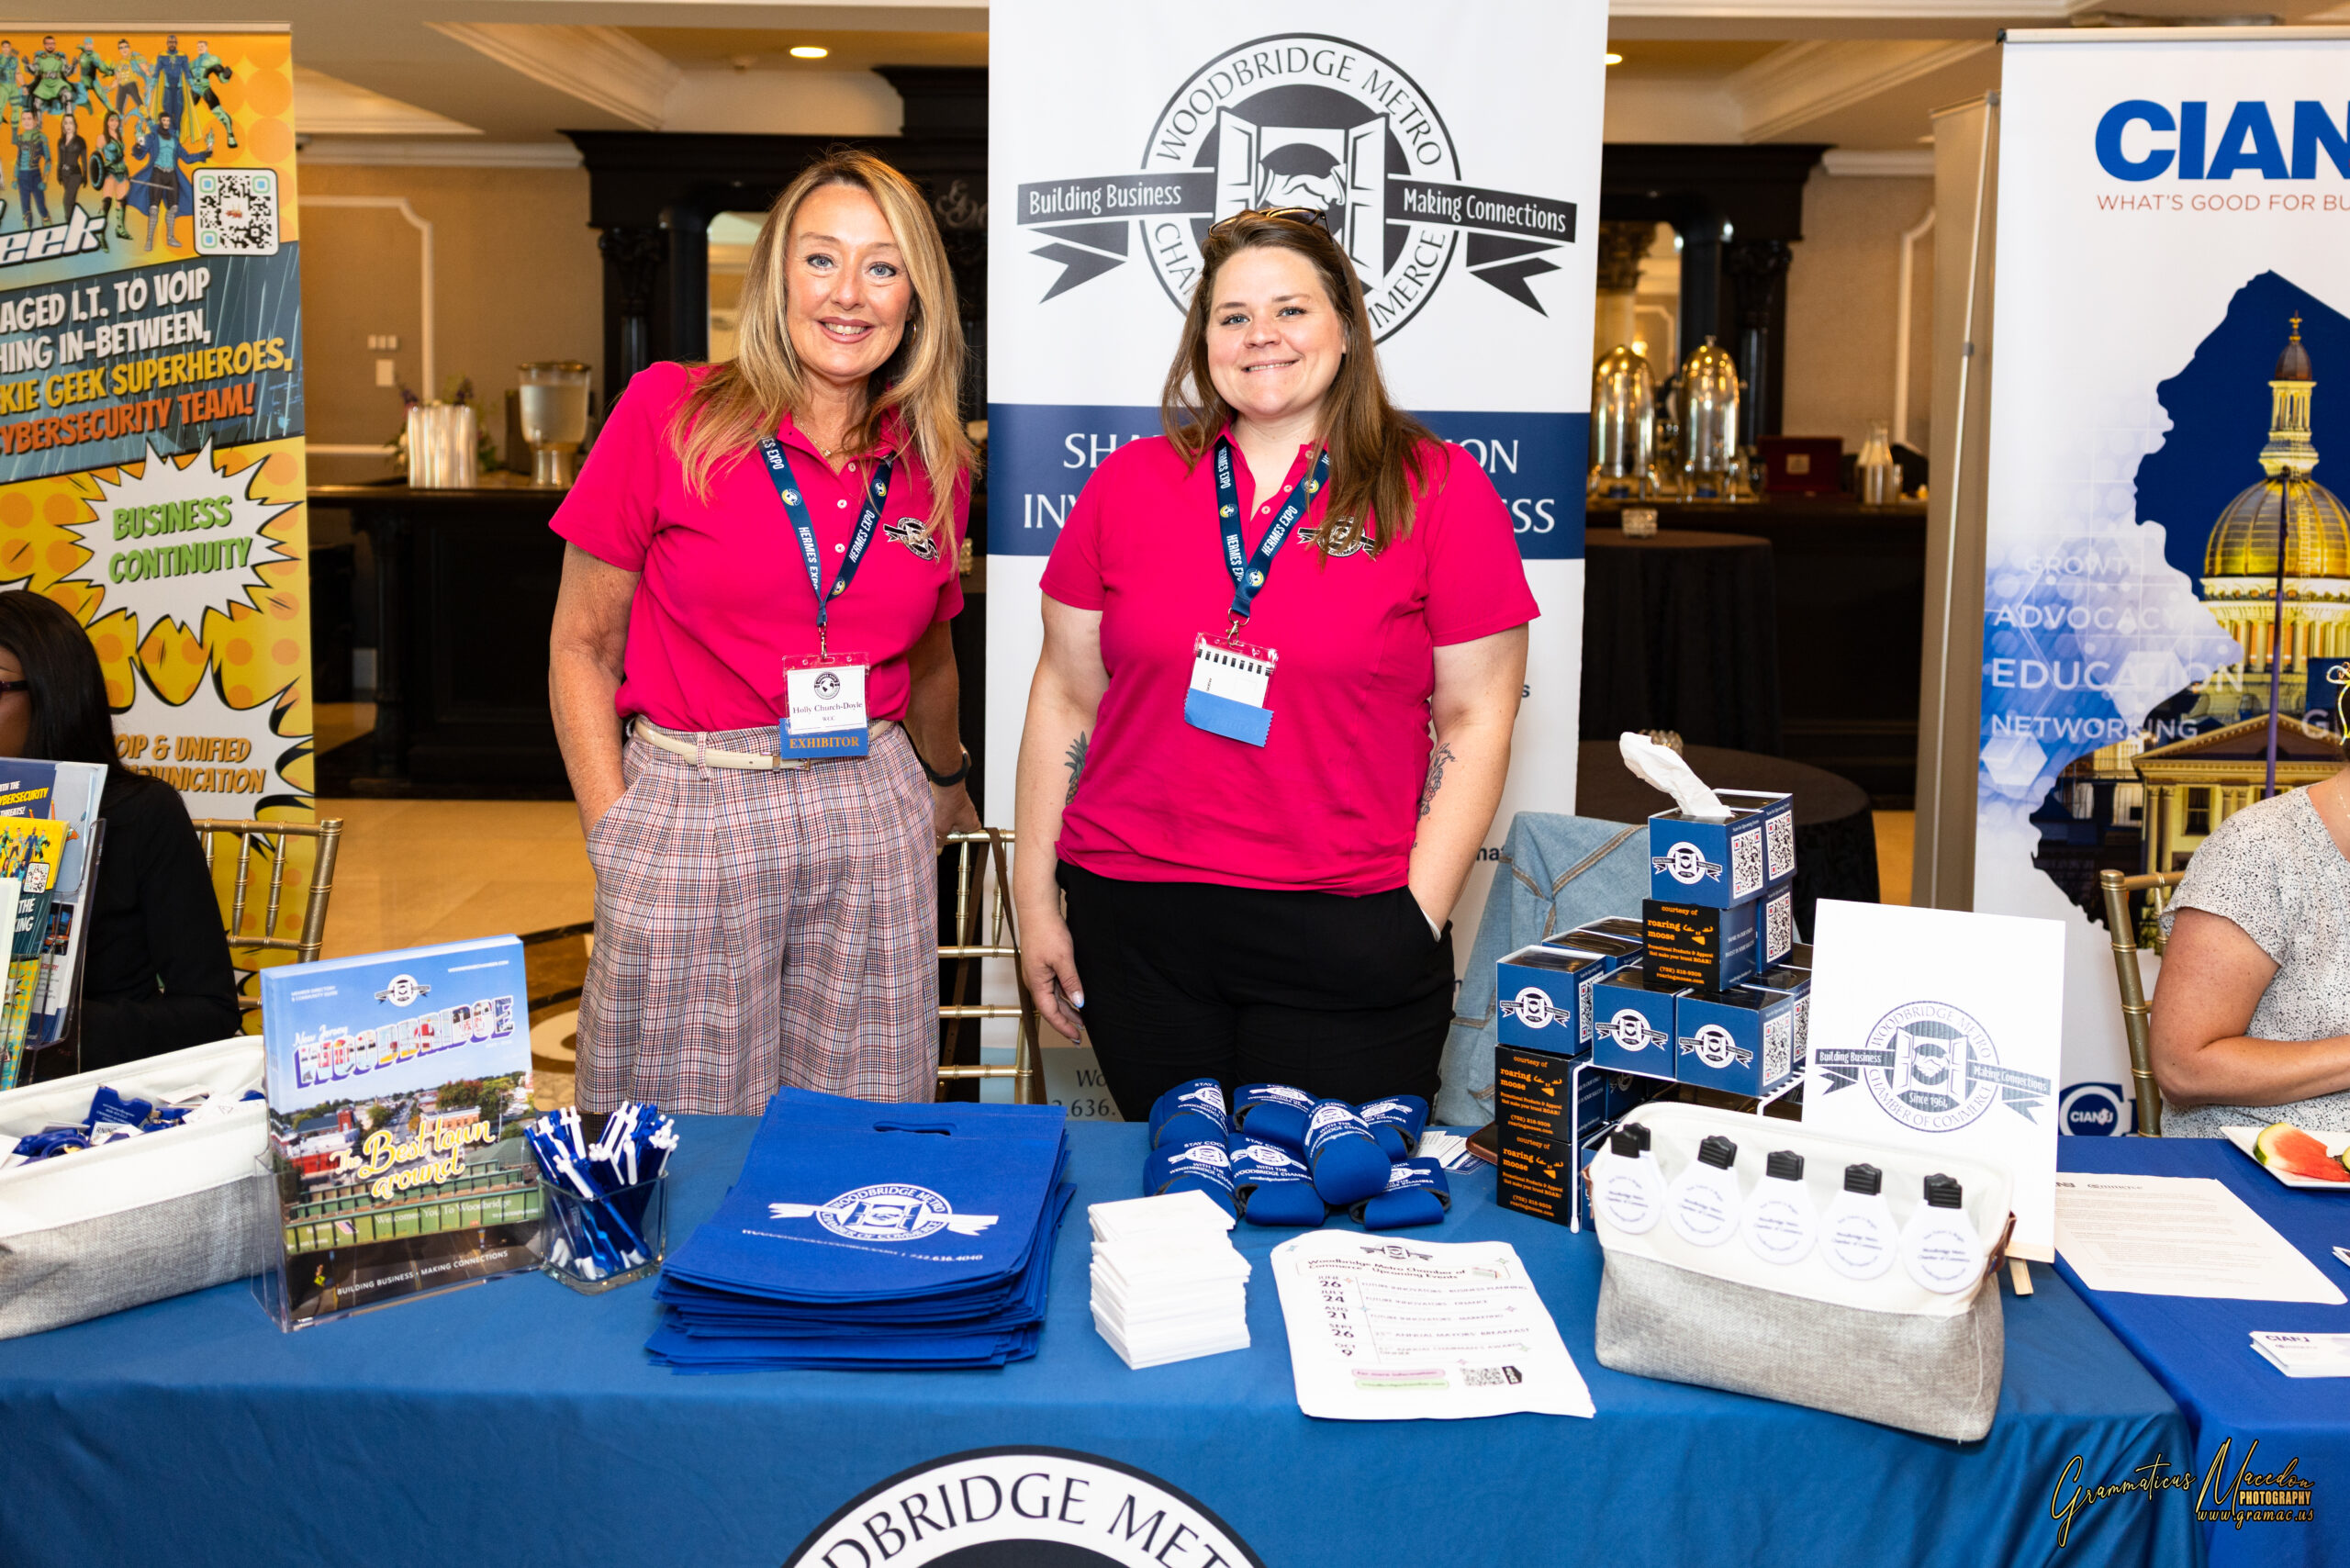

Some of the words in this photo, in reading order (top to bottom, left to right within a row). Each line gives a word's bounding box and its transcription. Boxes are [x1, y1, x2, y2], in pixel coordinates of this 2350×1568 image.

[1156, 46, 1357, 162] WOODBRIDGE
[1361, 67, 1444, 167] METRO
[1029, 189, 1102, 216] Building
[1106, 183, 1183, 208] Business
[2098, 194, 2183, 212] WHAT'S
[2191, 195, 2260, 212] GOOD
[2268, 195, 2315, 212] FOR
[1404, 187, 1463, 223] Making
[1466, 195, 1567, 232] Connections
[72, 286, 109, 321] I.T.
[114, 278, 148, 313] TO
[154, 267, 210, 308] VOIP
[59, 308, 211, 364] IN-BETWEEN,
[45, 366, 107, 409] GEEK
[111, 337, 293, 396] SUPERHEROES,
[177, 383, 256, 425] TEAM!
[766, 449, 785, 470] EXPO
[1218, 445, 1229, 473] HERMES
[1219, 471, 1232, 489] EXPO
[112, 495, 232, 543] BUSINESS
[848, 529, 869, 564] HERMES
[861, 510, 876, 532] EXPO
[1261, 524, 1286, 556] HERMES
[1281, 505, 1299, 527] EXPO
[798, 526, 817, 564] HERMES
[1226, 533, 1242, 566] HERMES
[108, 537, 252, 584] CONTINUITY
[2025, 553, 2143, 576] GROWTH
[1994, 603, 2183, 631] ADVOCACY
[1991, 657, 2244, 693] EDUCATION
[792, 706, 811, 715] Holly
[814, 701, 863, 712] Church-Doyle
[1991, 713, 2199, 740] NETWORKING
[151, 734, 171, 760] &
[174, 736, 251, 763] UNIFIED
[789, 736, 860, 749] EXHIBITOR
[17, 897, 36, 914] THE
[1662, 906, 1690, 916] courtesy
[1648, 919, 1681, 933] roaring
[1648, 930, 1675, 941] moose
[1693, 957, 1712, 965] ROAR!
[319, 1025, 349, 1044] Jersey
[1871, 1004, 1954, 1047] WOODBRIDGE
[1958, 1016, 1992, 1058] METRO
[294, 995, 514, 1090] WOODBRIDGE
[1513, 1056, 1540, 1067] courtesy
[1819, 1050, 1849, 1064] Building
[1850, 1051, 1882, 1063] Business
[1500, 1069, 1531, 1082] roaring
[1500, 1079, 1526, 1091] moose
[1974, 1065, 2001, 1082] Making
[2001, 1071, 2047, 1092] Connections
[1868, 1068, 1912, 1123] CHAMBER
[1913, 1113, 1931, 1127] OF
[1932, 1083, 1992, 1128] COMMERCE
[1908, 1092, 1930, 1104] Since
[1930, 1097, 1948, 1108] 1964
[1319, 1123, 1337, 1135] WITH
[330, 1148, 364, 1174] The
[357, 1120, 427, 1180] Best
[431, 1116, 497, 1153] town
[1203, 1140, 1226, 1149] COOL
[1245, 1137, 1264, 1146] STAY
[1264, 1143, 1287, 1153] COOL
[1516, 1137, 1542, 1148] courtesy
[1502, 1159, 1528, 1171] moose
[1503, 1148, 1534, 1163] roaring
[371, 1147, 465, 1200] around
[1169, 1165, 1215, 1176] WOODBRIDGE
[1192, 1162, 1213, 1171] WITH
[1234, 1169, 1280, 1178] WOODBRIDGE
[1281, 1172, 1313, 1182] CHAMBER
[1256, 1163, 1274, 1172] WITH
[827, 1186, 916, 1209] WOODBRIDGE
[916, 1192, 946, 1213] METRO
[877, 1221, 944, 1240] COMMERCE
[337, 1280, 375, 1296] BUILDING
[376, 1271, 414, 1286] BUSINESS
[420, 1261, 453, 1276] MAKING
[453, 1249, 509, 1269] CONNECTIONS
[1371, 1267, 1424, 1279] Upcoming
[1326, 1311, 1347, 1319] 21
[1331, 1328, 1354, 1338] 26
